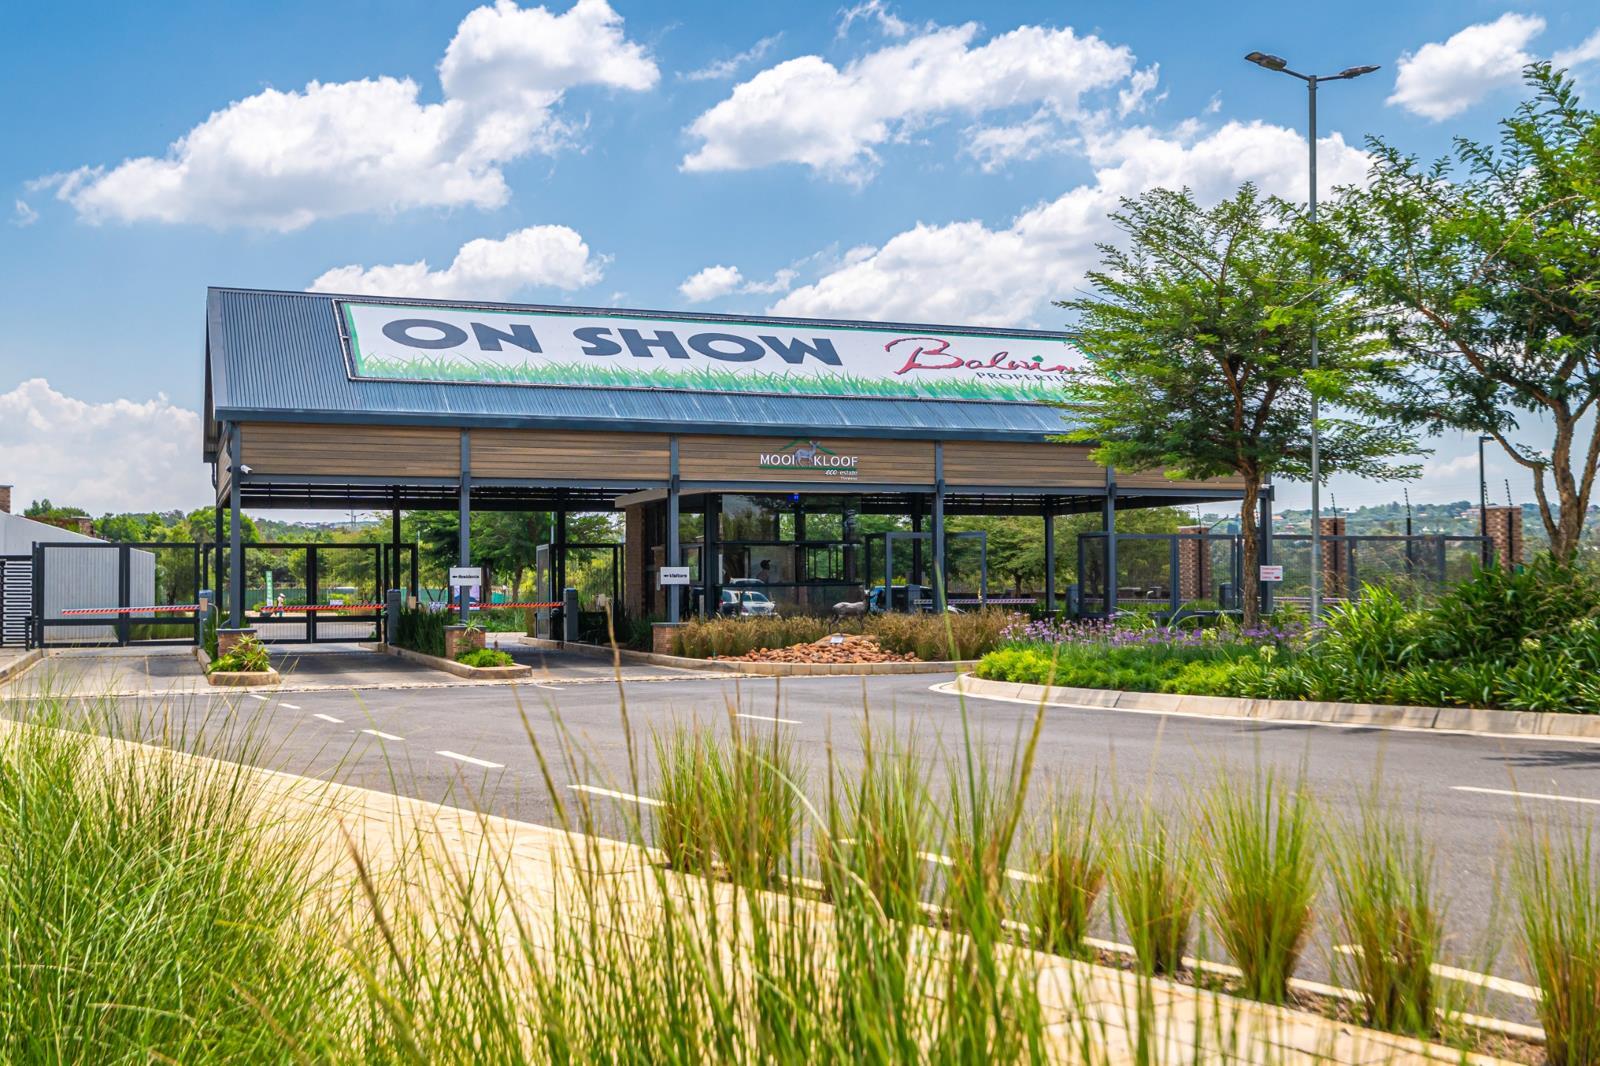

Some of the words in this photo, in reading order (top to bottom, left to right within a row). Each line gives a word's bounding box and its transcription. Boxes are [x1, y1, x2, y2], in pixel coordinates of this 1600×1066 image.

[381, 318, 543, 354] ON
[572, 327, 843, 366] SHOW
[760, 454, 795, 466] MOOI
[814, 455, 858, 467] KLOOF
